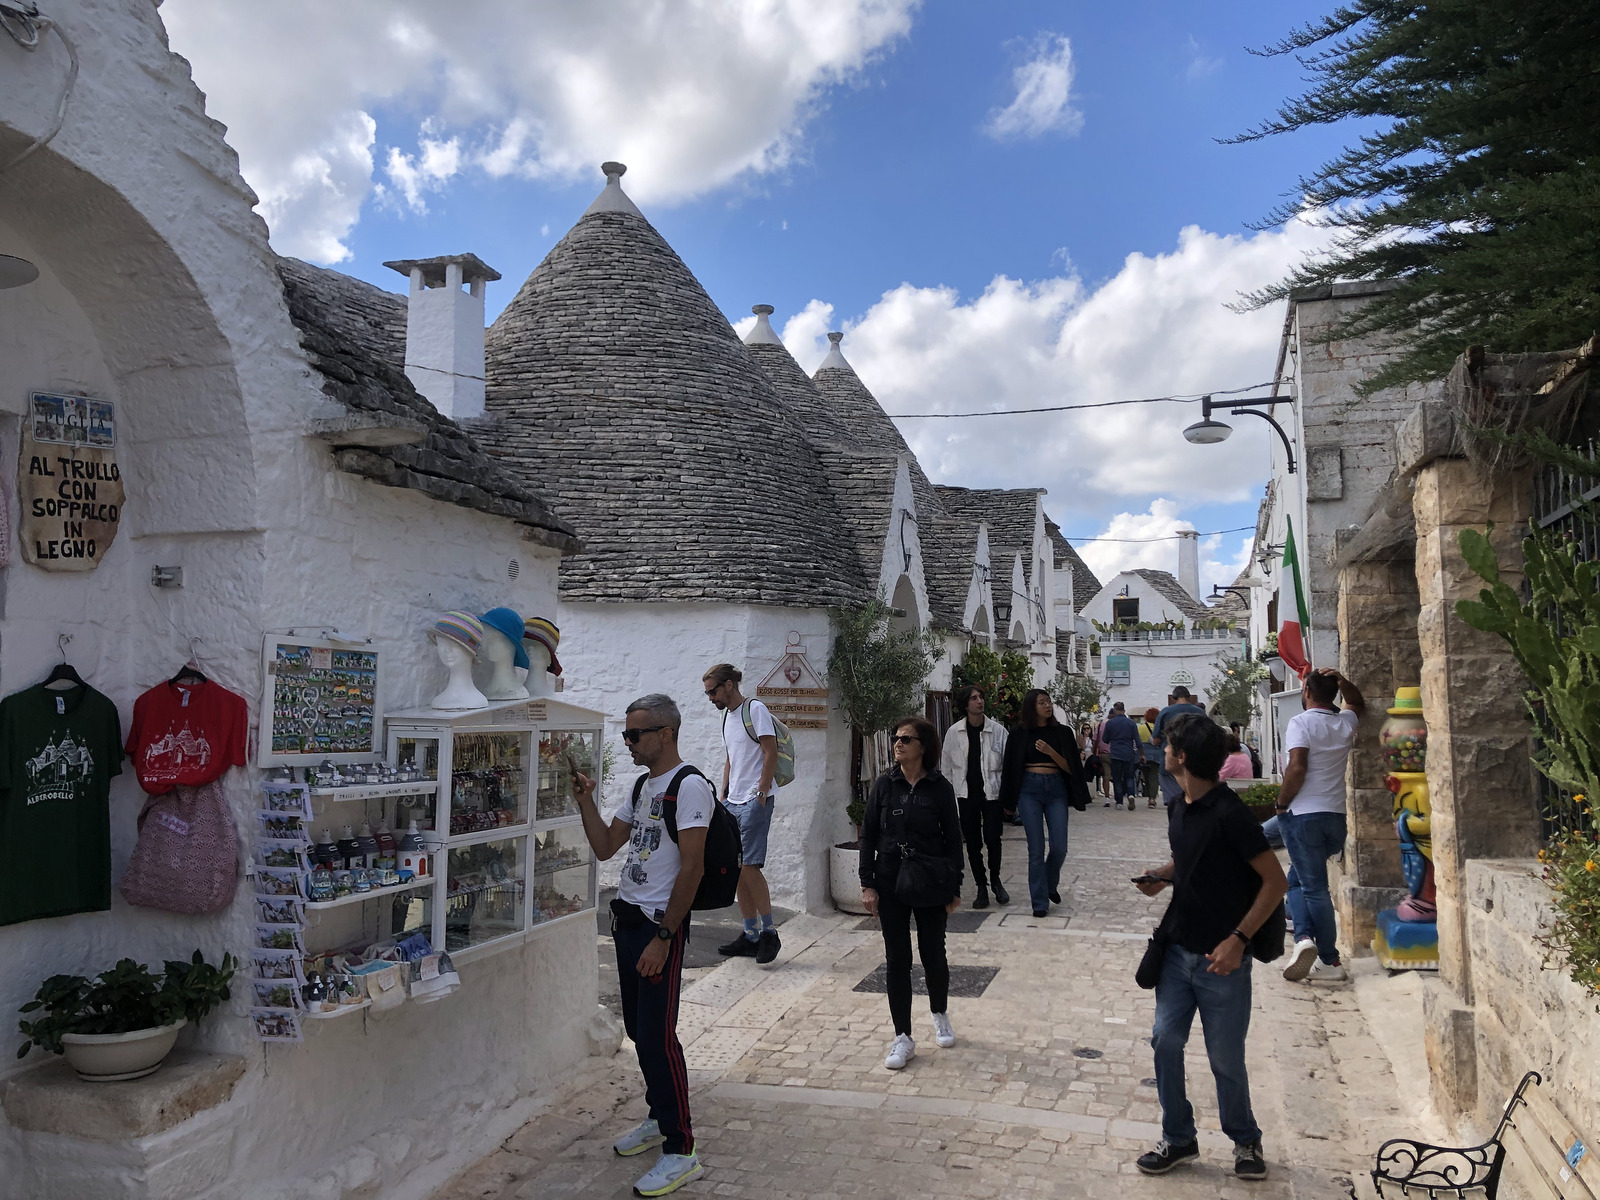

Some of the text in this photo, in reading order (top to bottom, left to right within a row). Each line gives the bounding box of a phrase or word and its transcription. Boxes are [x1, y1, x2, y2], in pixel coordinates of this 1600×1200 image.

[44, 411, 105, 431] PUGLIA
[29, 456, 120, 482] AL TRULLO
[58, 480, 97, 501] CON
[32, 498, 118, 523] SOPPALCO
[63, 521, 83, 538] IN
[36, 539, 96, 559] LEGNO
[27, 791, 74, 806] ALBEROBELLO
